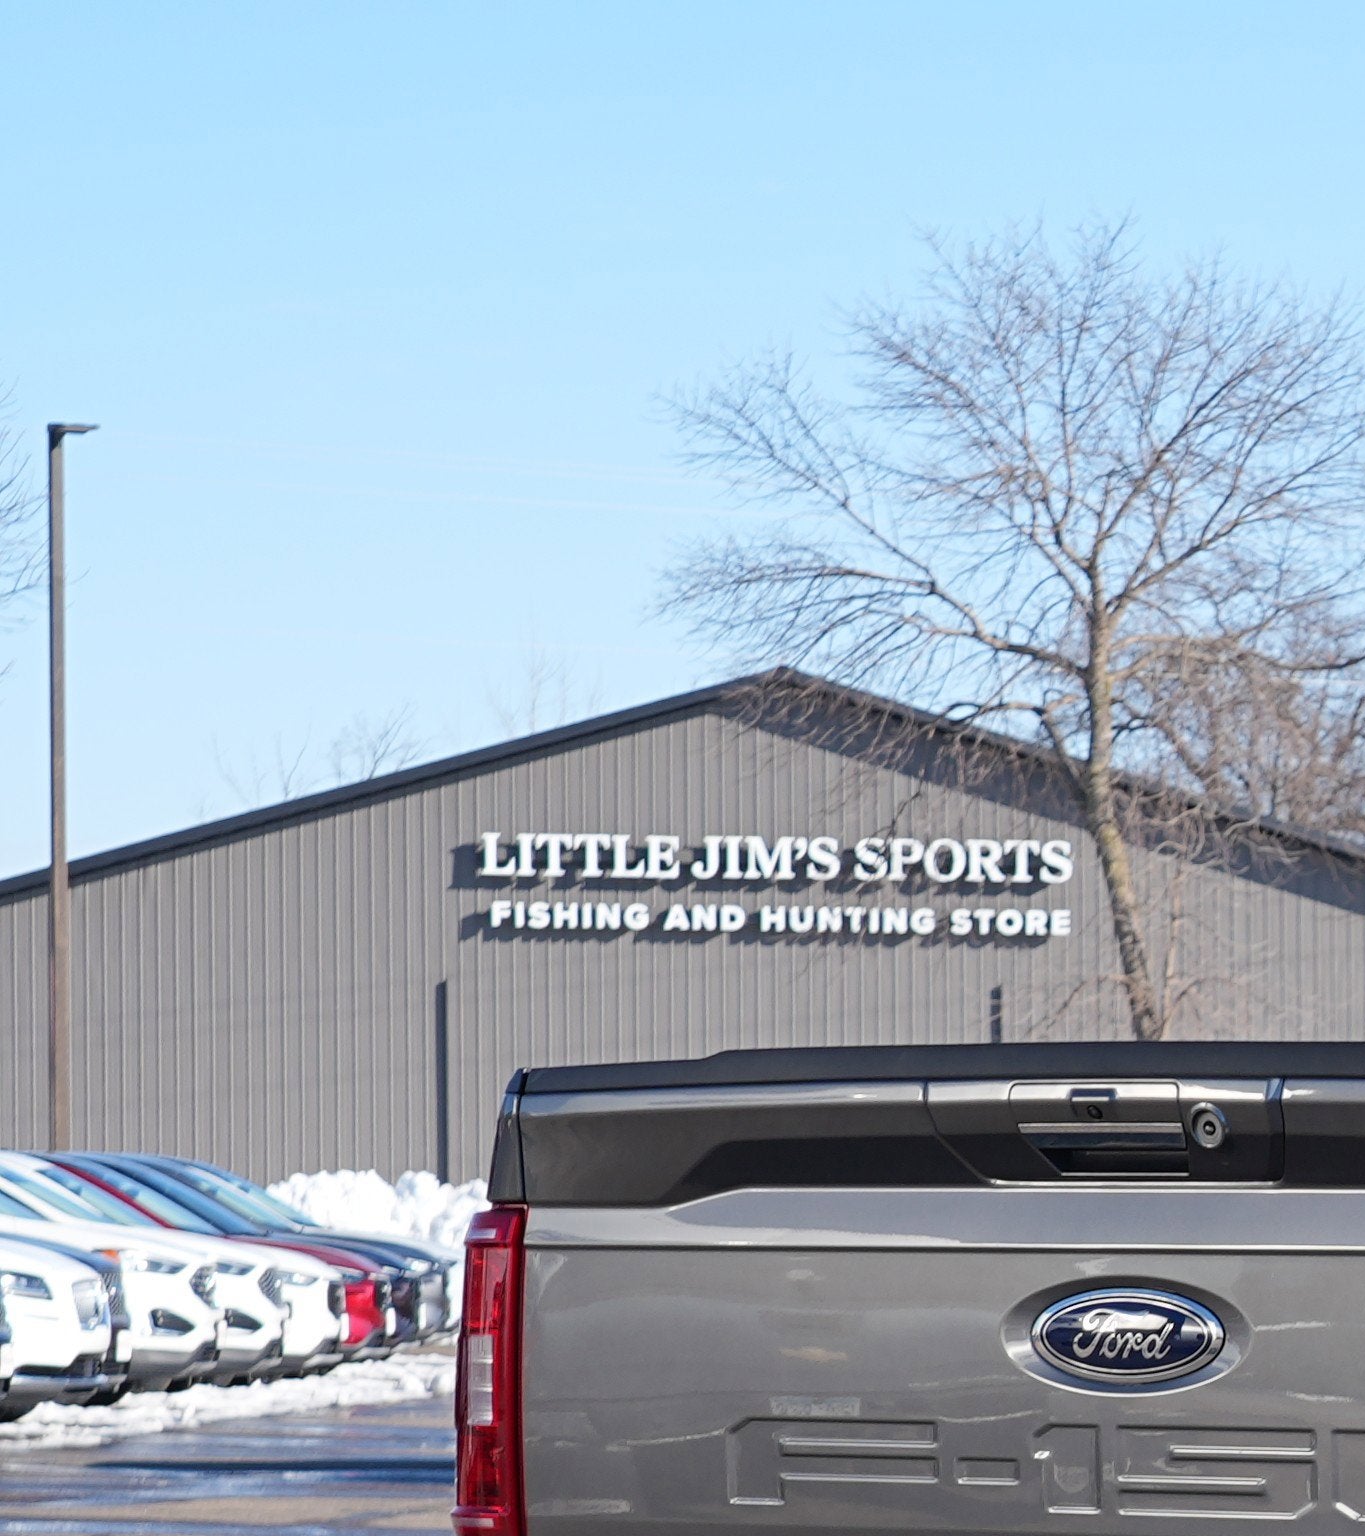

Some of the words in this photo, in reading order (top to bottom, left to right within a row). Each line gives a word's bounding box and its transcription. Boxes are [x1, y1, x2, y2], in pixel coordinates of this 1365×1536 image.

[480, 832, 680, 880] LITTLE
[692, 835, 840, 881] JIM'S
[854, 838, 1073, 884] SPORTS
[491, 901, 649, 930] FISHING
[663, 905, 746, 932] AND
[760, 905, 935, 935] HUNTING
[950, 908, 1071, 936] STORE
[1073, 1309, 1174, 1360] Ford
